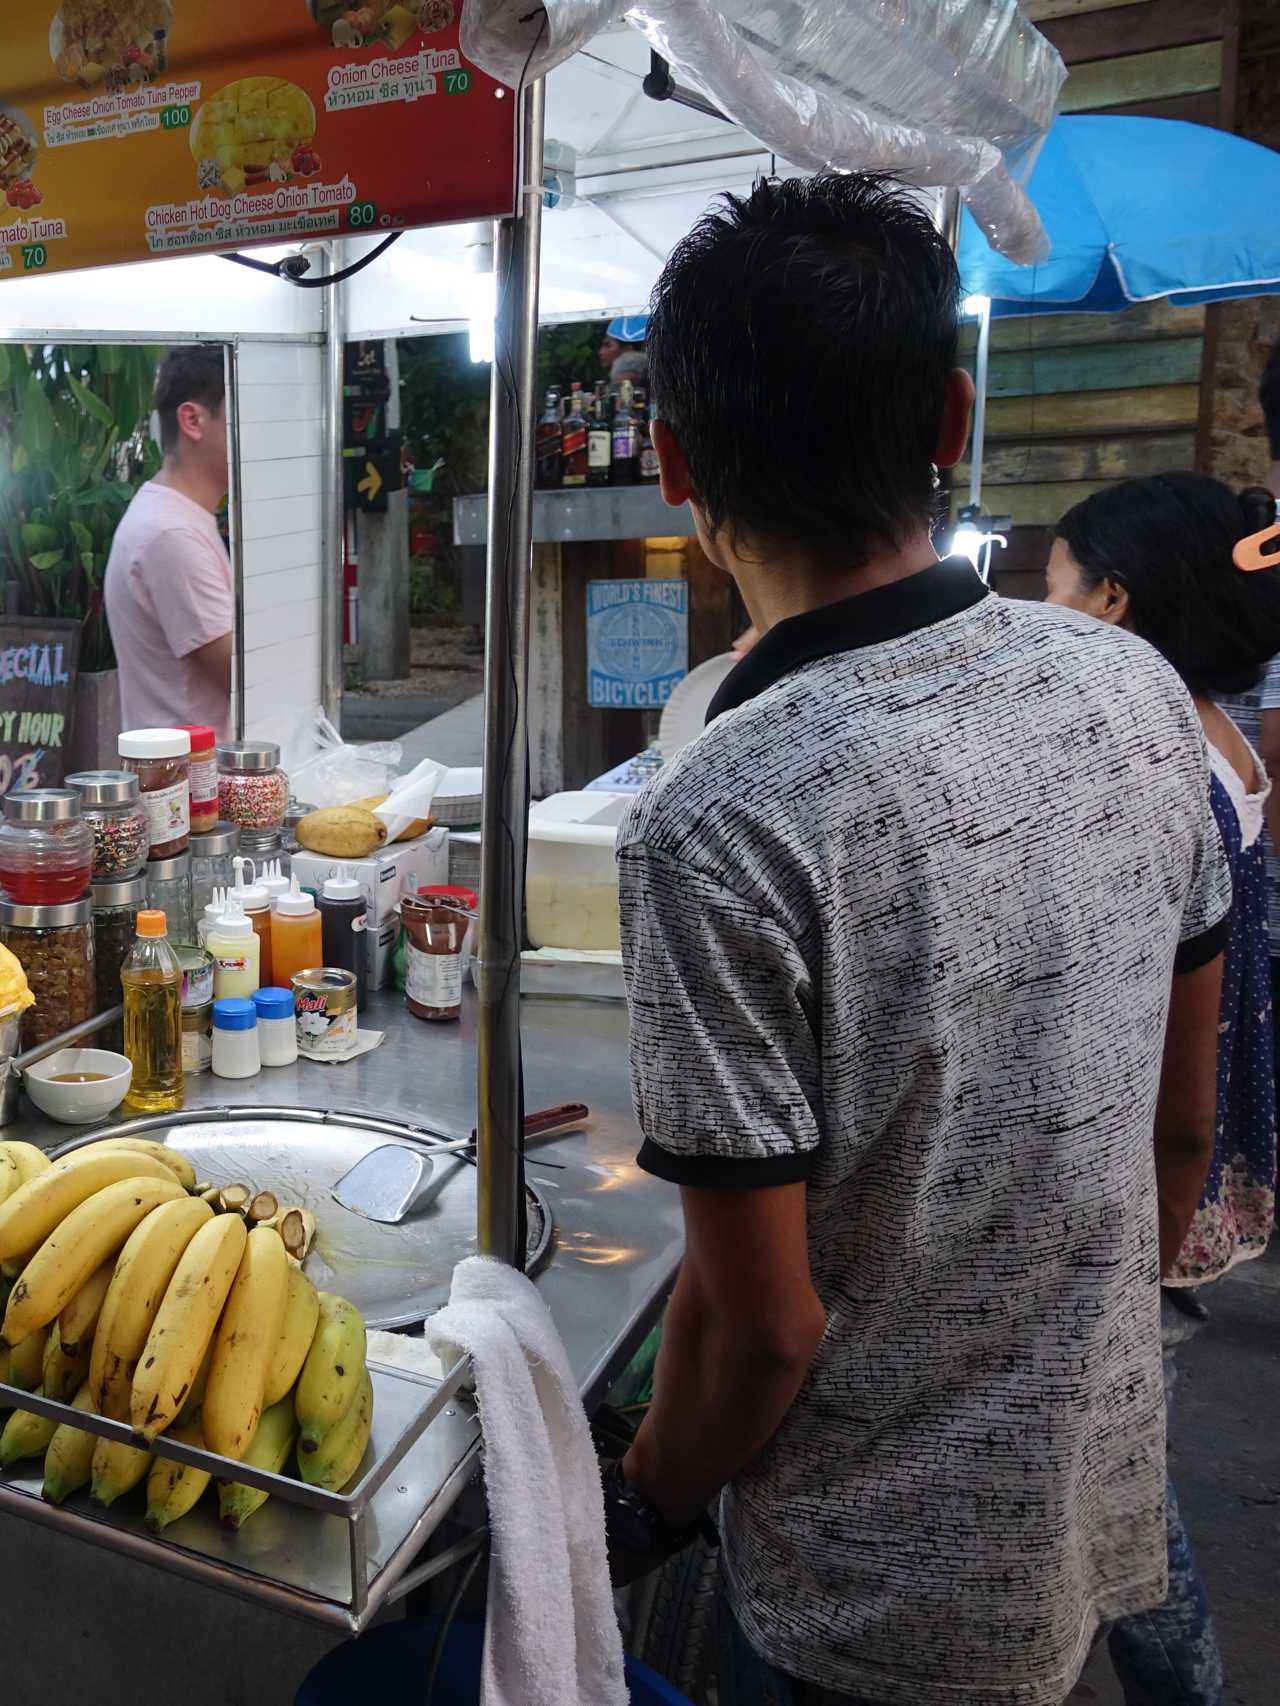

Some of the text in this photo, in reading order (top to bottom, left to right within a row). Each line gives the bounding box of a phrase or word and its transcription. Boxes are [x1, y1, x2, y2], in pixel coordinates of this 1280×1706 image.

[331, 53, 456, 86] Onion Cheese Tuna
[328, 87, 374, 107] หัวหอม
[379, 79, 400, 98] ชีส
[447, 73, 468, 92] 70
[46, 84, 199, 125] Egg Cheese Onion Tomato Tuna Pepper
[163, 107, 189, 126] 100
[148, 185, 353, 226] Chicken Hot Dog Cheese Onion Tomato
[350, 204, 374, 224] 80
[30, 220, 63, 239] Tuna
[23, 247, 44, 267] 70
[643, 582, 687, 611] FINEST
[17, 711, 65, 747] HOUR
[297, 993, 329, 1012] Mali
